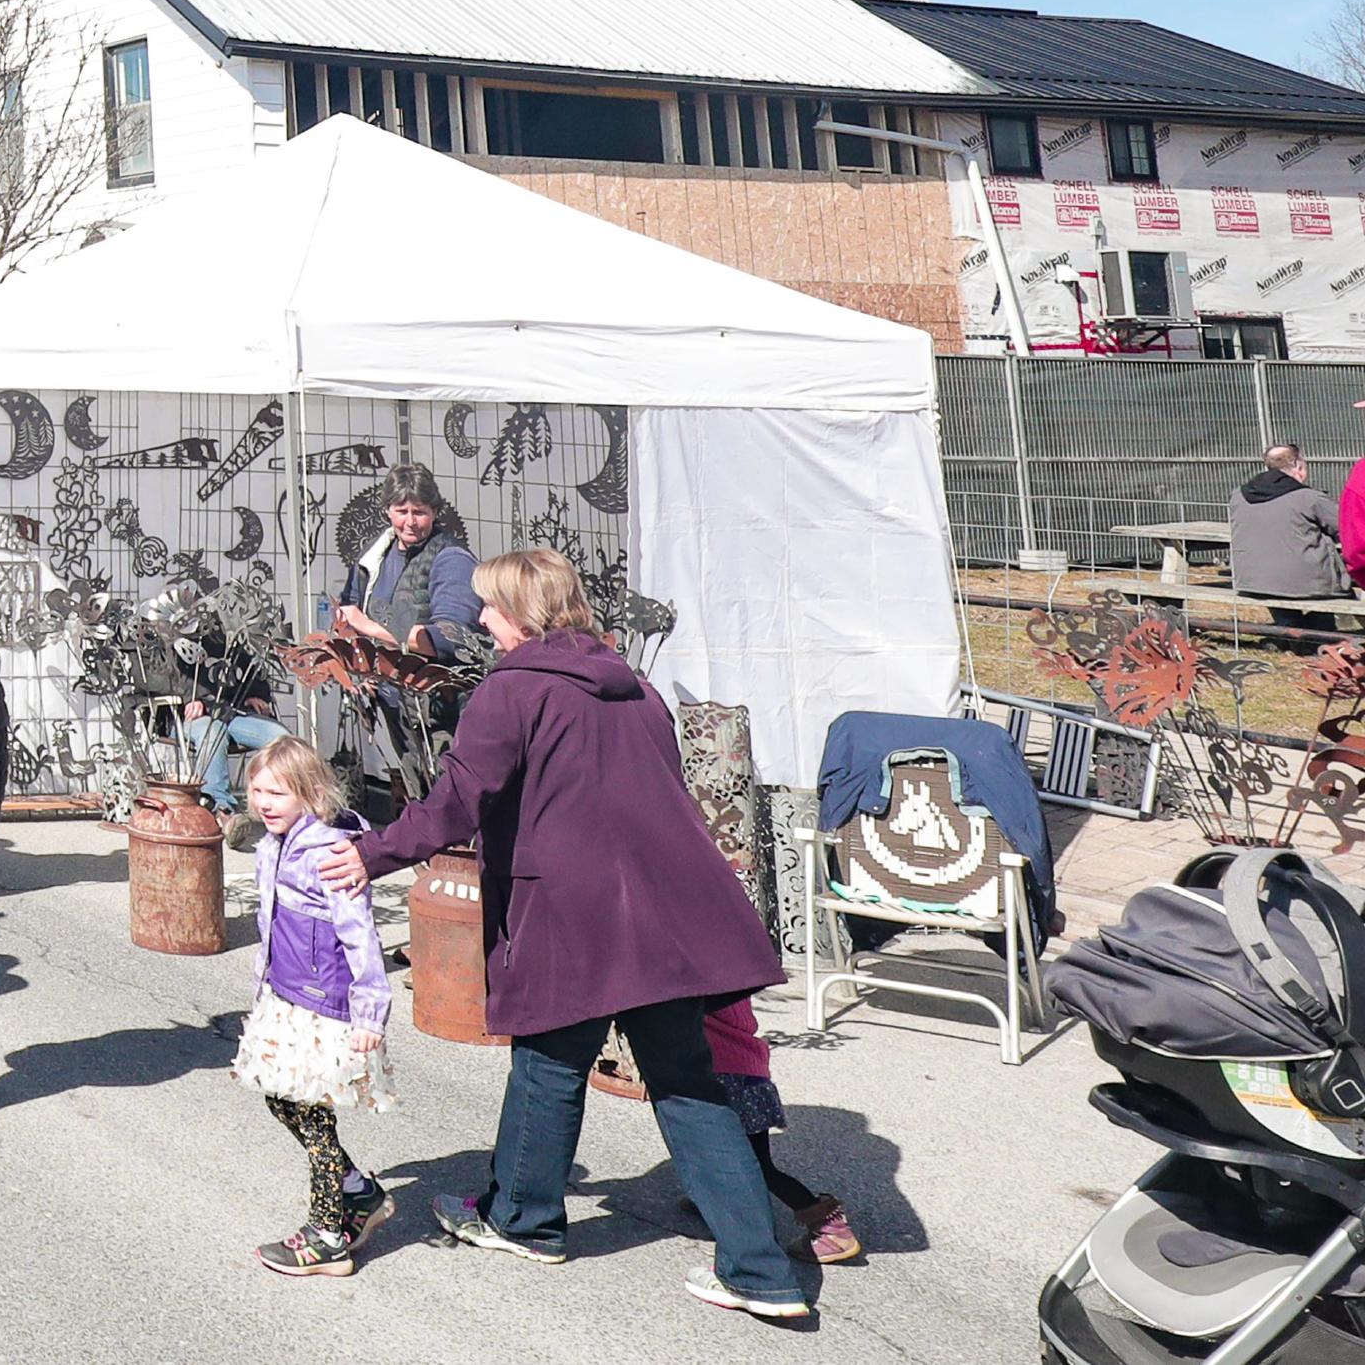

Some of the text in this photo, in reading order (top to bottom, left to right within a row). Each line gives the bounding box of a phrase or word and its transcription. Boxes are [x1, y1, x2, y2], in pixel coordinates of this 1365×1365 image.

[1042, 122, 1093, 155] NovaWrap
[1200, 130, 1247, 161] NovaWrap
[1053, 180, 1097, 192] SCHELL
[1133, 183, 1175, 195] SCHELL
[1211, 186, 1253, 198] SCHELL
[1053, 192, 1100, 205] LUMBER
[1287, 189, 1327, 201] SCHELL
[1134, 196, 1179, 208] LUMBER
[1212, 198, 1257, 211] LUMBER
[1288, 201, 1330, 214] LUMBER
[1021, 252, 1069, 285] NovaWrap
[1256, 259, 1303, 291] NovaWrap
